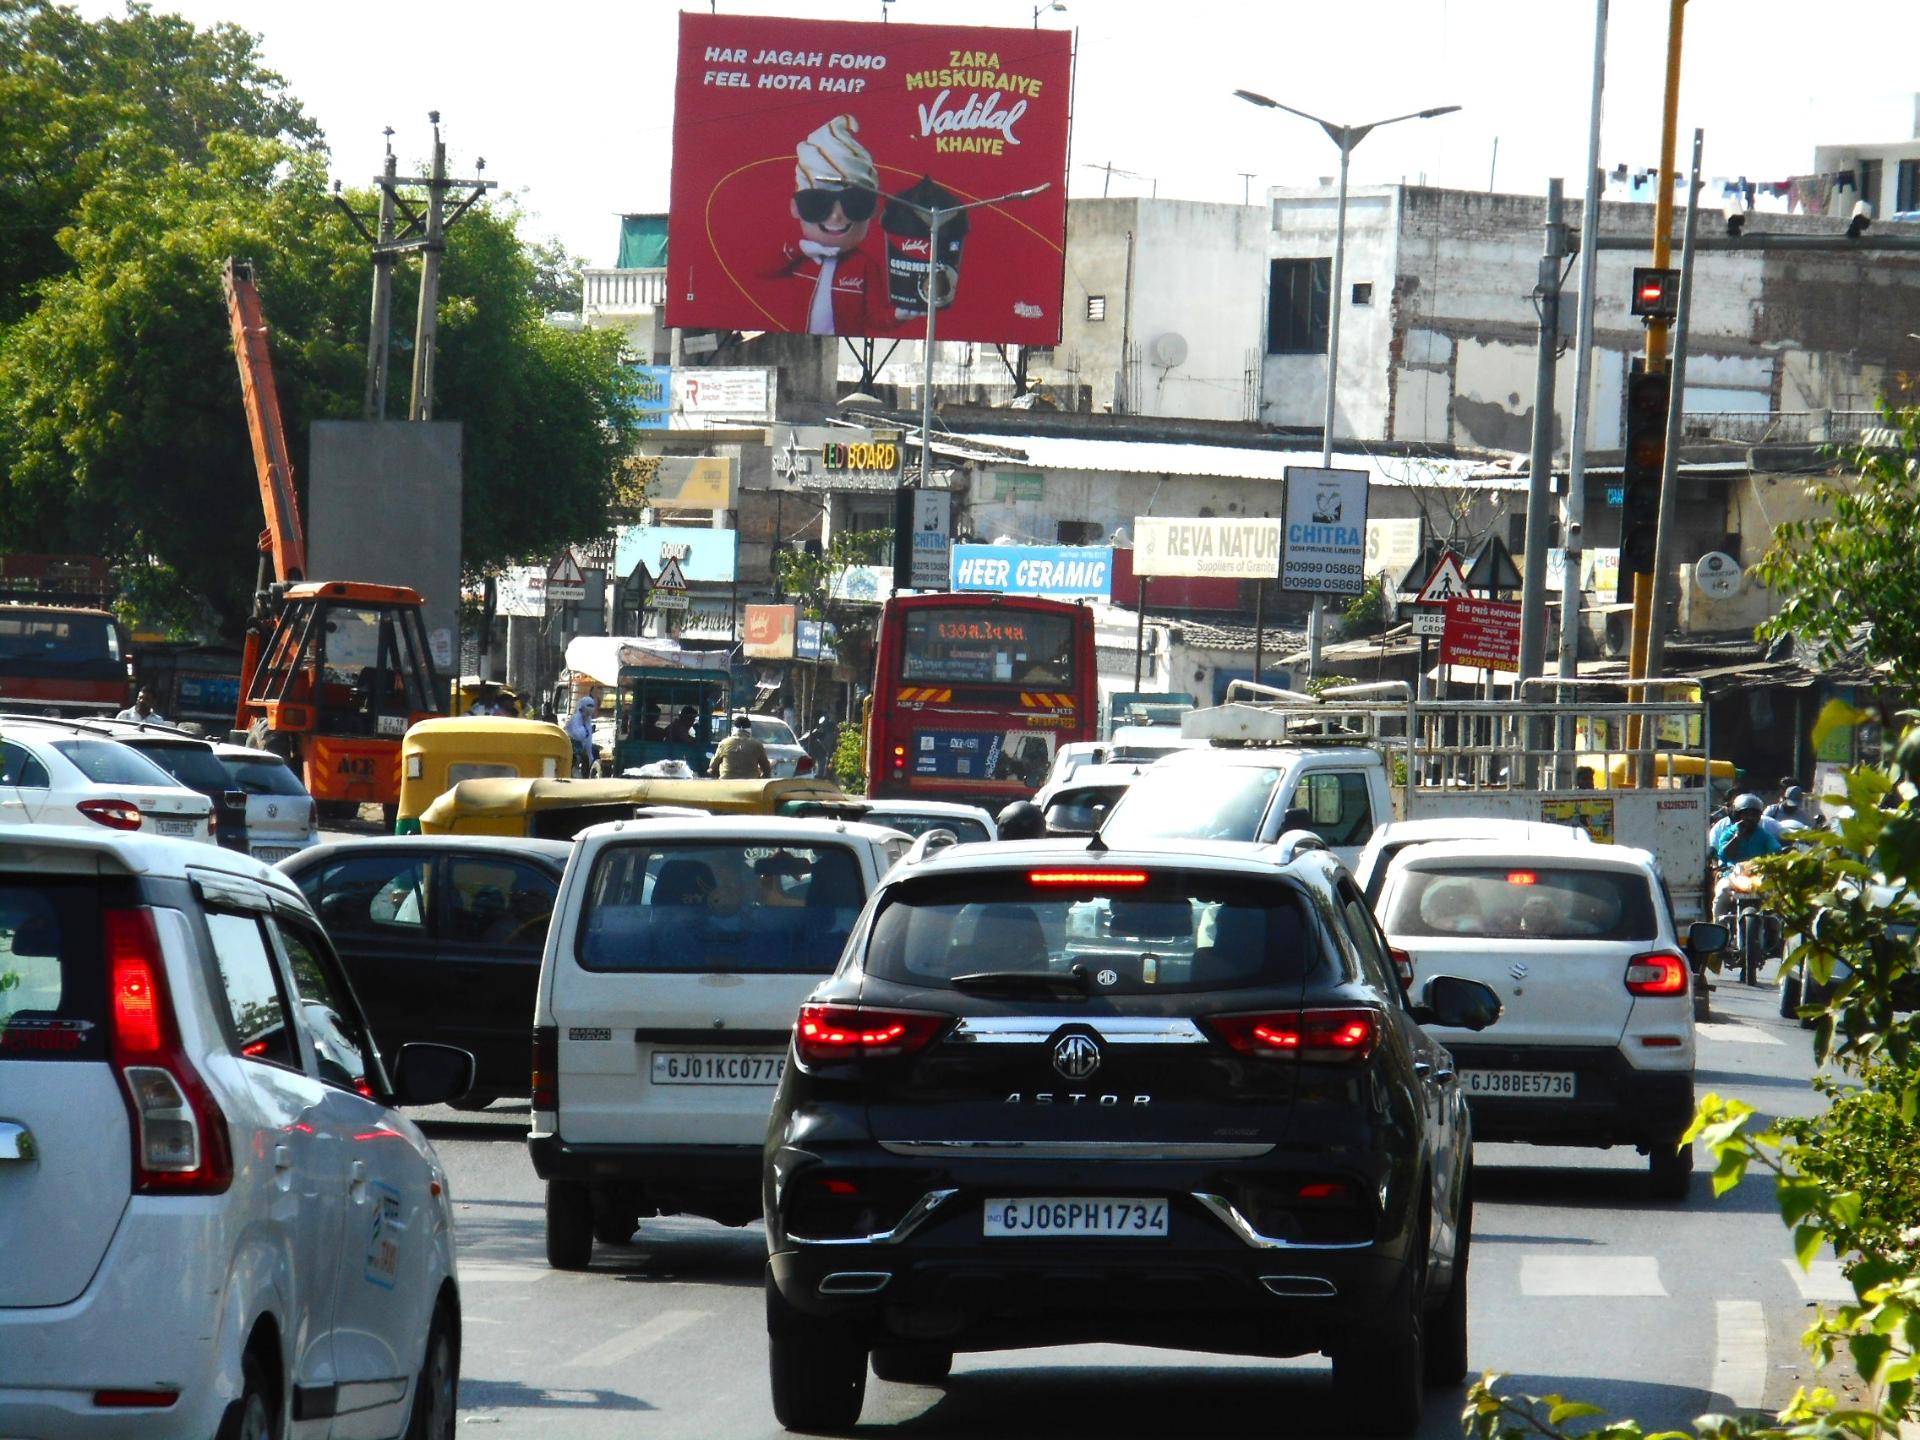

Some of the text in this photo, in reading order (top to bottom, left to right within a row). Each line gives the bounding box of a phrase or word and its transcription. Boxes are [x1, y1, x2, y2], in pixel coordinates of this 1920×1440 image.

[704, 46, 887, 70] HAR JAGAH FOMO
[949, 50, 1000, 69] ZARA
[703, 71, 866, 93] FEEL HOTA HAI?
[906, 69, 1043, 98] MUSKURAIYE
[918, 89, 1028, 145] Vadilal
[936, 136, 1005, 156] KHAIYE
[822, 442, 897, 470] LED BOARD
[912, 532, 947, 549] CHITRA
[1167, 525, 1213, 557] REVA
[1289, 523, 1360, 546] CHITRA
[1306, 545, 1333, 554] PRIVATE
[1334, 547, 1361, 555] LIMITED
[958, 558, 1106, 589] HEER CERAMIC
[1197, 559, 1234, 573] Suppliers
[1236, 559, 1245, 572] of
[1285, 561, 1361, 575] 90999 05862
[1284, 576, 1361, 591] 90999 05868
[339, 755, 376, 778] ACE
[1055, 1036, 1098, 1078] MG
[1471, 1074, 1572, 1093] GJ38BE5736
[1004, 1092, 1151, 1107] ASTOR
[1003, 1204, 1164, 1230] GJ06PH1734
